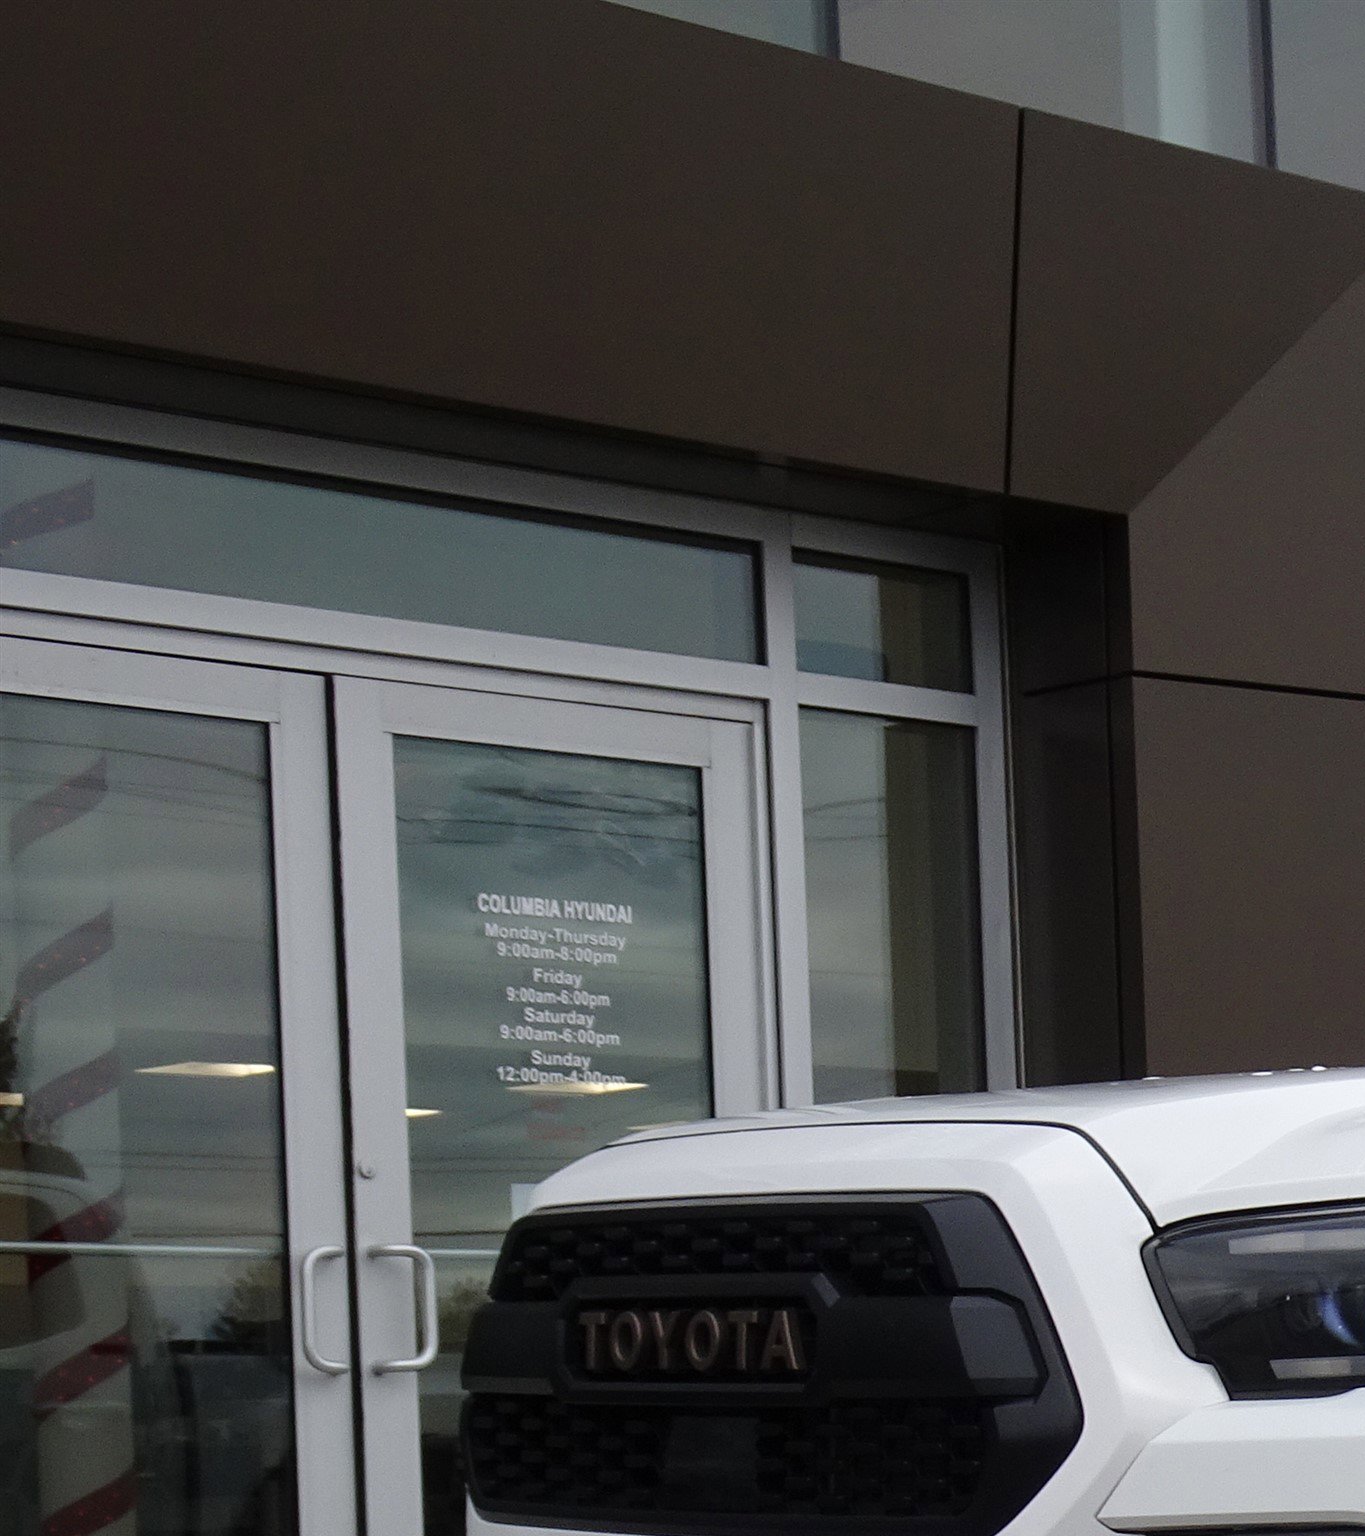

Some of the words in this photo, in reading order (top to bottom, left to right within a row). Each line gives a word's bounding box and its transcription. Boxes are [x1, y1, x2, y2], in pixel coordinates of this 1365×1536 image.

[477, 893, 562, 919] COLUMBIA
[564, 899, 632, 924] HYUNDAI
[485, 923, 626, 950] Monday-Thursday
[497, 941, 618, 965] 9:00am-8:00pm
[533, 968, 582, 989] Friday
[506, 987, 611, 1008] 9:00am-6:00pm
[523, 1007, 595, 1028] Saturday
[500, 1025, 621, 1048] 9:00am-6:00pm
[531, 1050, 591, 1071] Sunday
[496, 1066, 627, 1085] 12:00pm-4:00pm
[579, 1309, 803, 1372] TOYOTA
